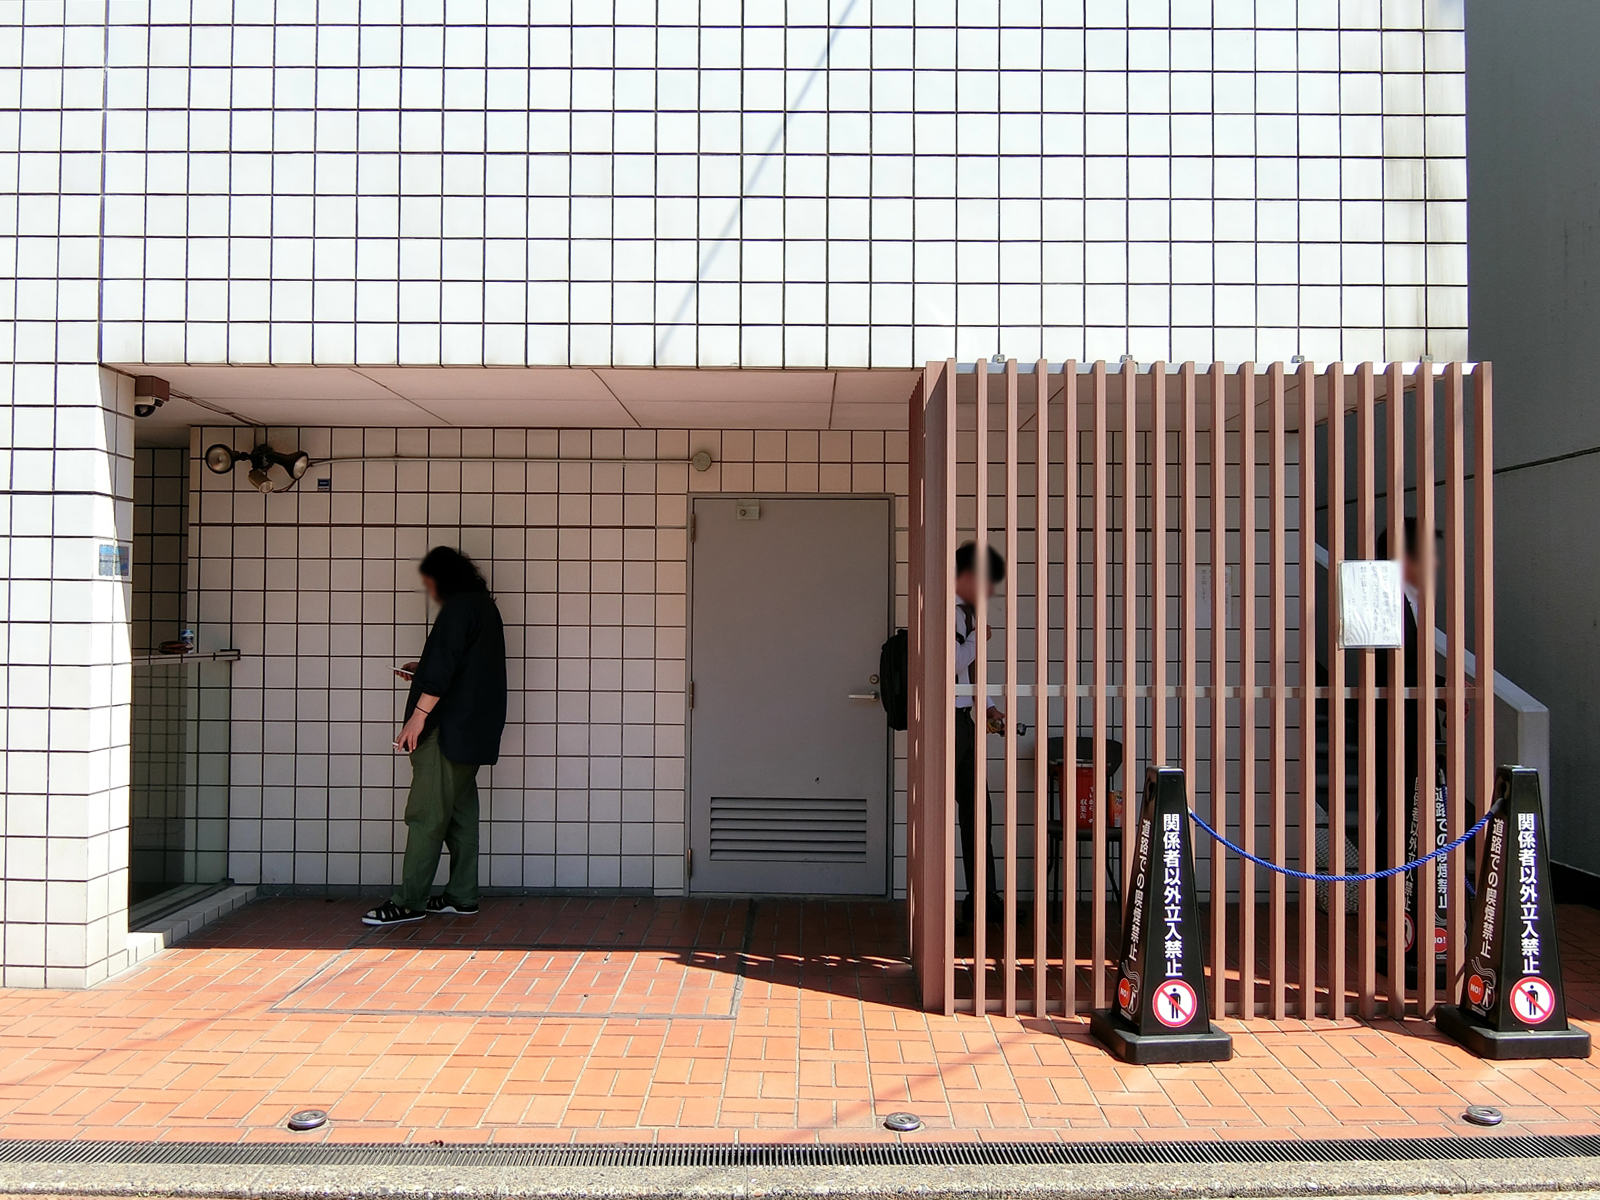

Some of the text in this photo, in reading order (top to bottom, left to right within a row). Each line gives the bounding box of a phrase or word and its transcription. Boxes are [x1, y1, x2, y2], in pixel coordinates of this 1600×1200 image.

[1128, 818, 1151, 962] 道路での喫煙禁止
[1162, 813, 1183, 977] 関係者以外立入禁止
[1480, 818, 1505, 959] 道路での喫煙禁止
[1517, 812, 1541, 974] 関係者以外立入禁止
[1120, 986, 1129, 999] NO!
[1470, 983, 1481, 995] NO!
